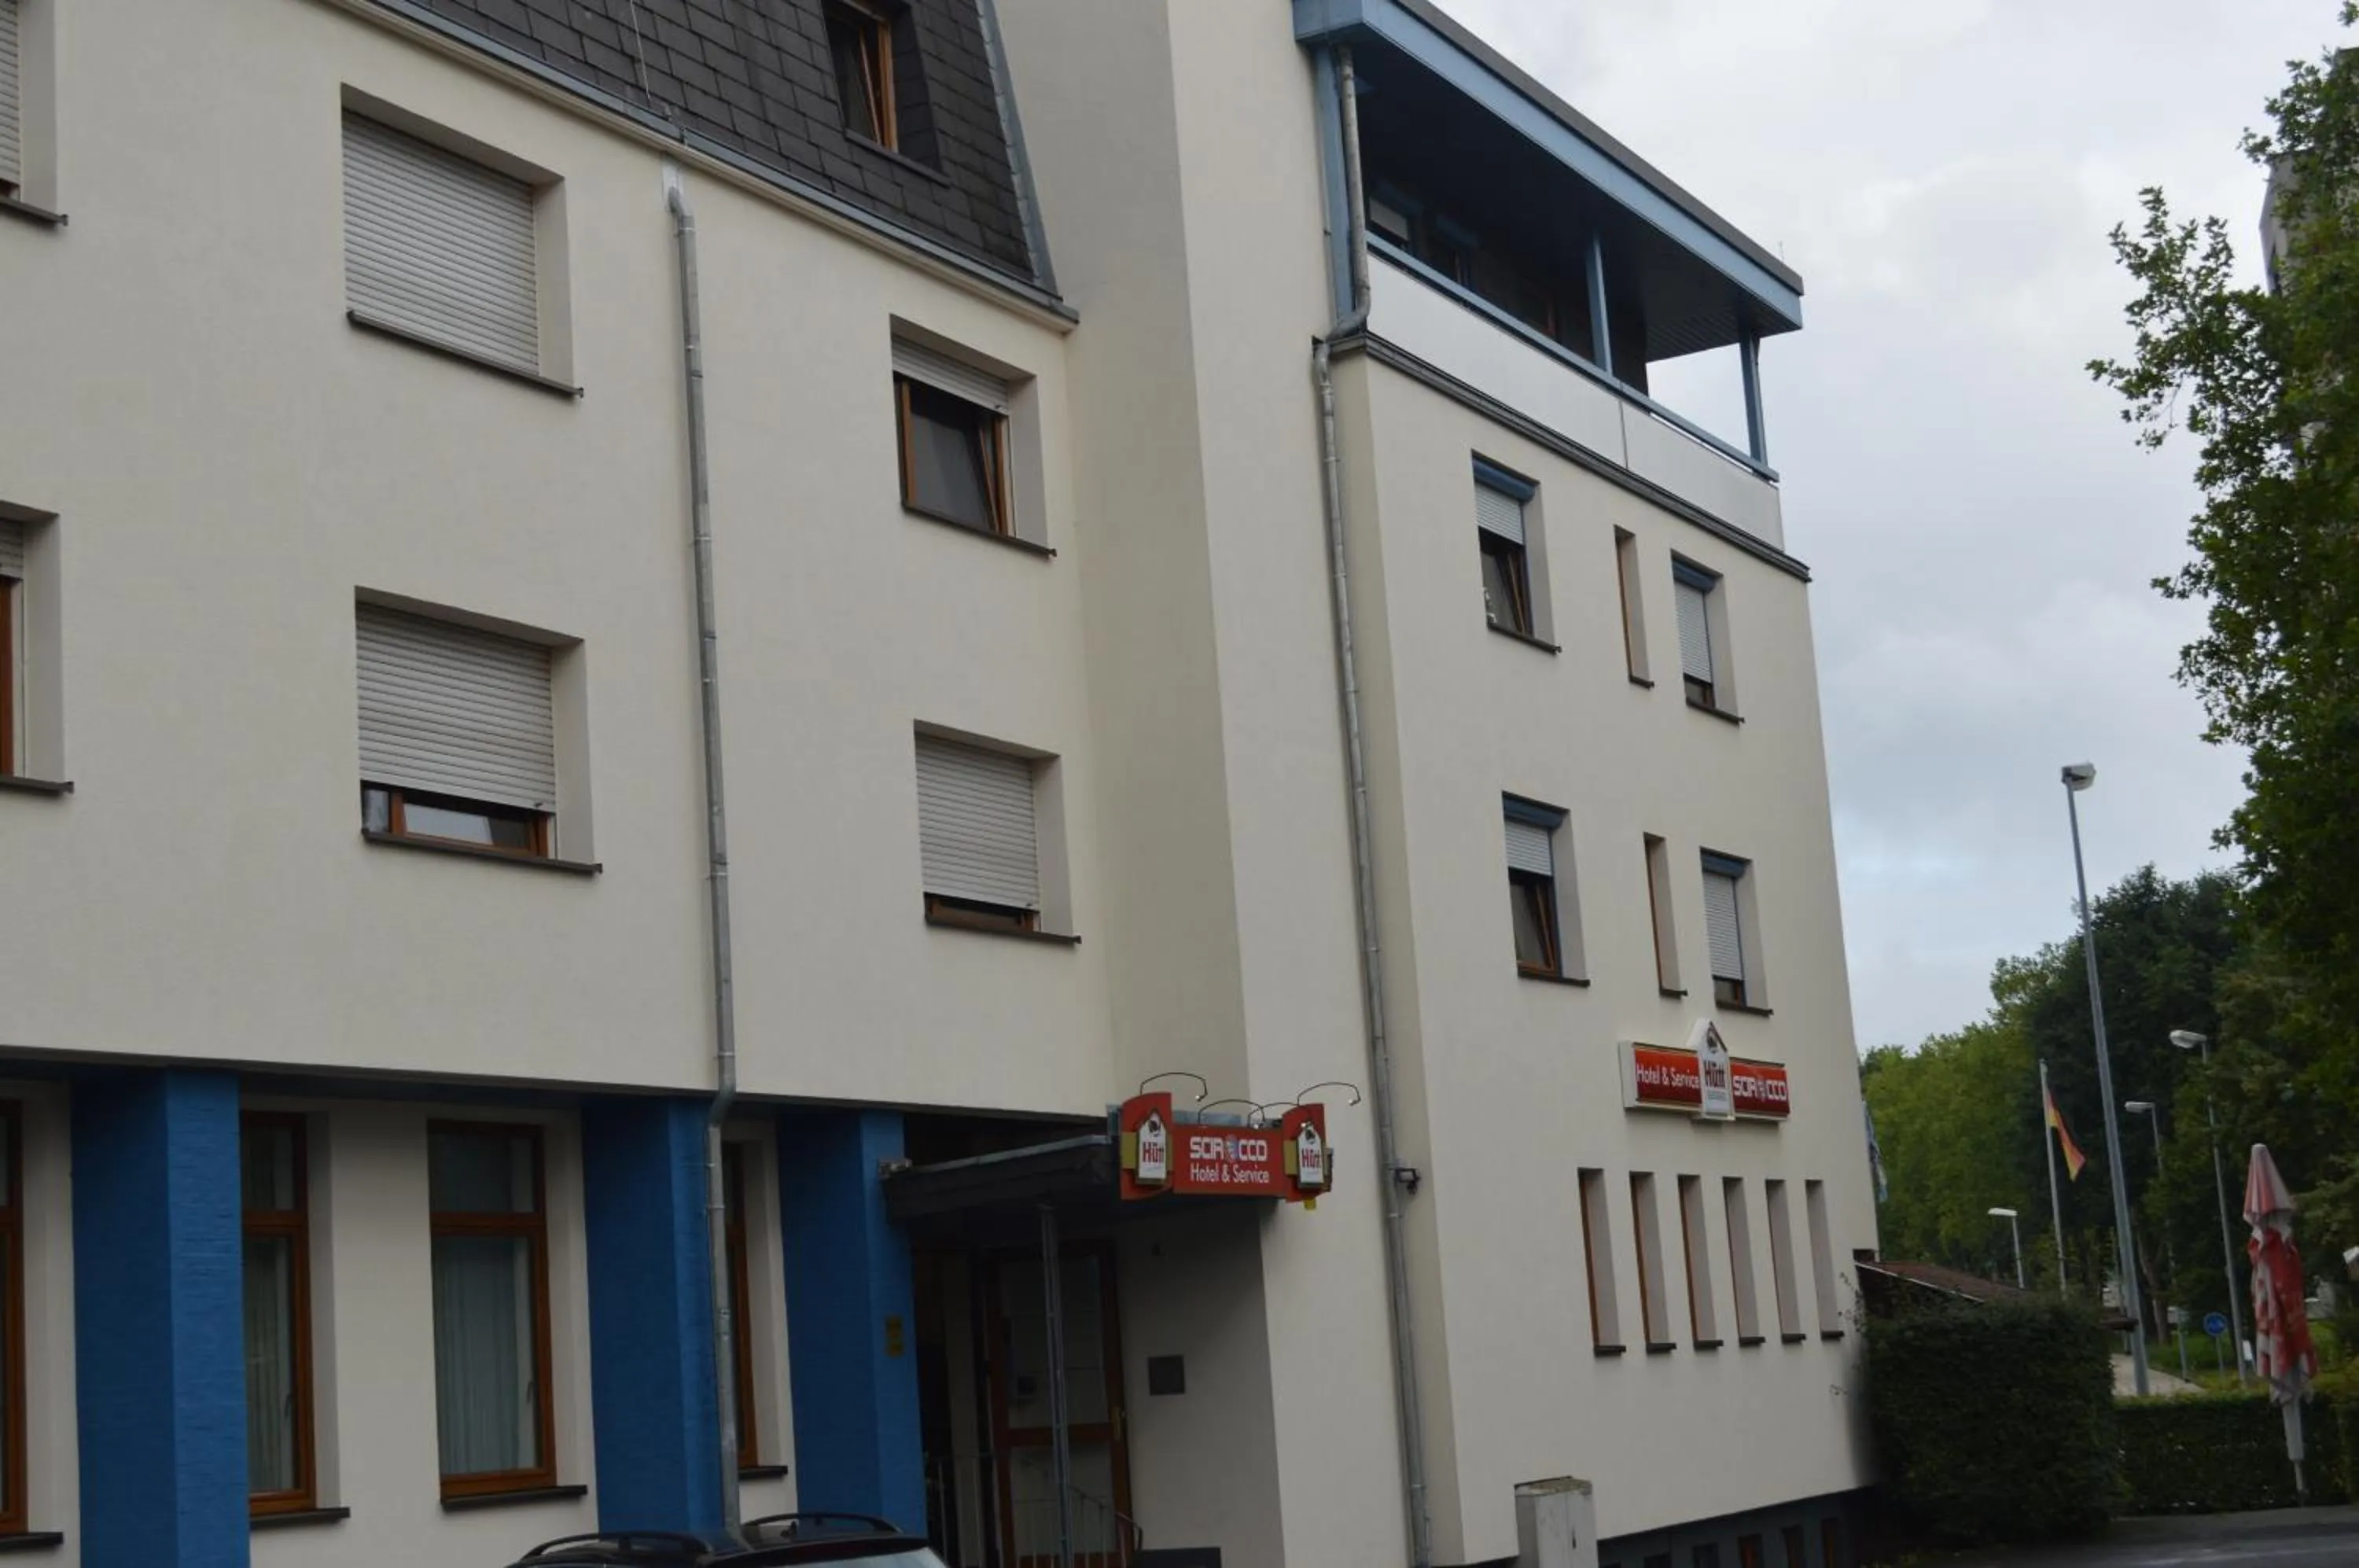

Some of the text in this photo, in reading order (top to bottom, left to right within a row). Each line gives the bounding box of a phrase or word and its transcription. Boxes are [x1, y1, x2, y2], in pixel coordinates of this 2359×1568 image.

[1636, 1063, 1699, 1089] Hotel & Service
[1191, 1162, 1270, 1183] Hotel & Service
